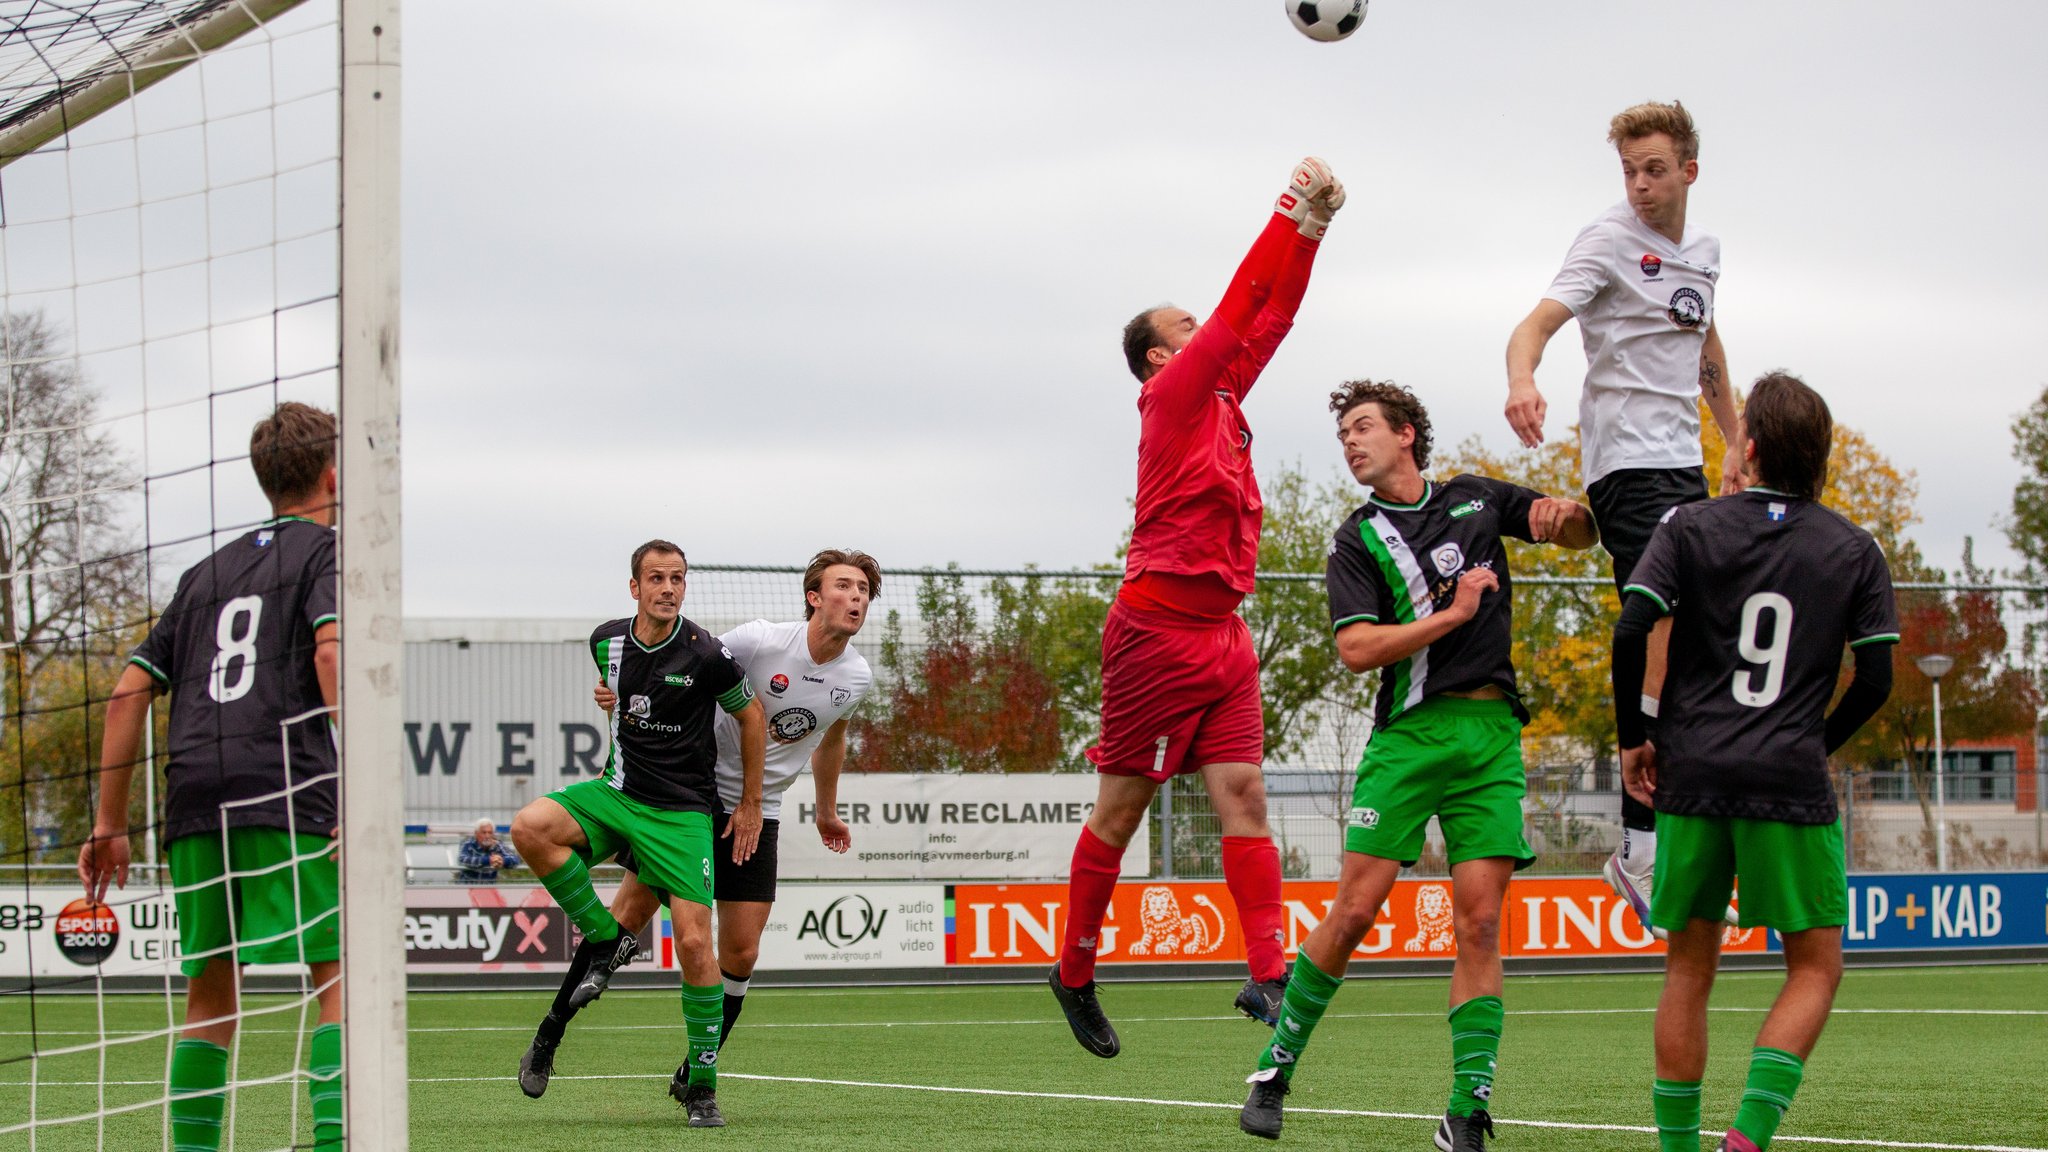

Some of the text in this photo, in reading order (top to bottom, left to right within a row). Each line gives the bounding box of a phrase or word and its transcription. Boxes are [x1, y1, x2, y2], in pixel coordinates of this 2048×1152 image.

[1671, 289, 1704, 311] USINESSCLUB
[209, 595, 263, 704] 8
[1731, 592, 1793, 708] 9
[639, 720, 682, 732] Oviron
[1153, 736, 1169, 772] 1
[799, 802, 1095, 824] HER UW RECLAME?
[929, 833, 957, 844] info:
[858, 850, 1029, 862] sponsoring@vvmeerburg.nl
[702, 857, 710, 876] 3
[898, 902, 934, 914] audio
[58, 918, 116, 932] SPORT
[764, 923, 788, 932] aties
[797, 909, 888, 940] ALV
[906, 920, 934, 932] licht
[1284, 899, 1397, 954] NG
[64, 933, 111, 947] 2000
[405, 908, 549, 962] eautyX
[900, 940, 935, 951] video
[804, 951, 882, 962] www.alvgroup.nl
